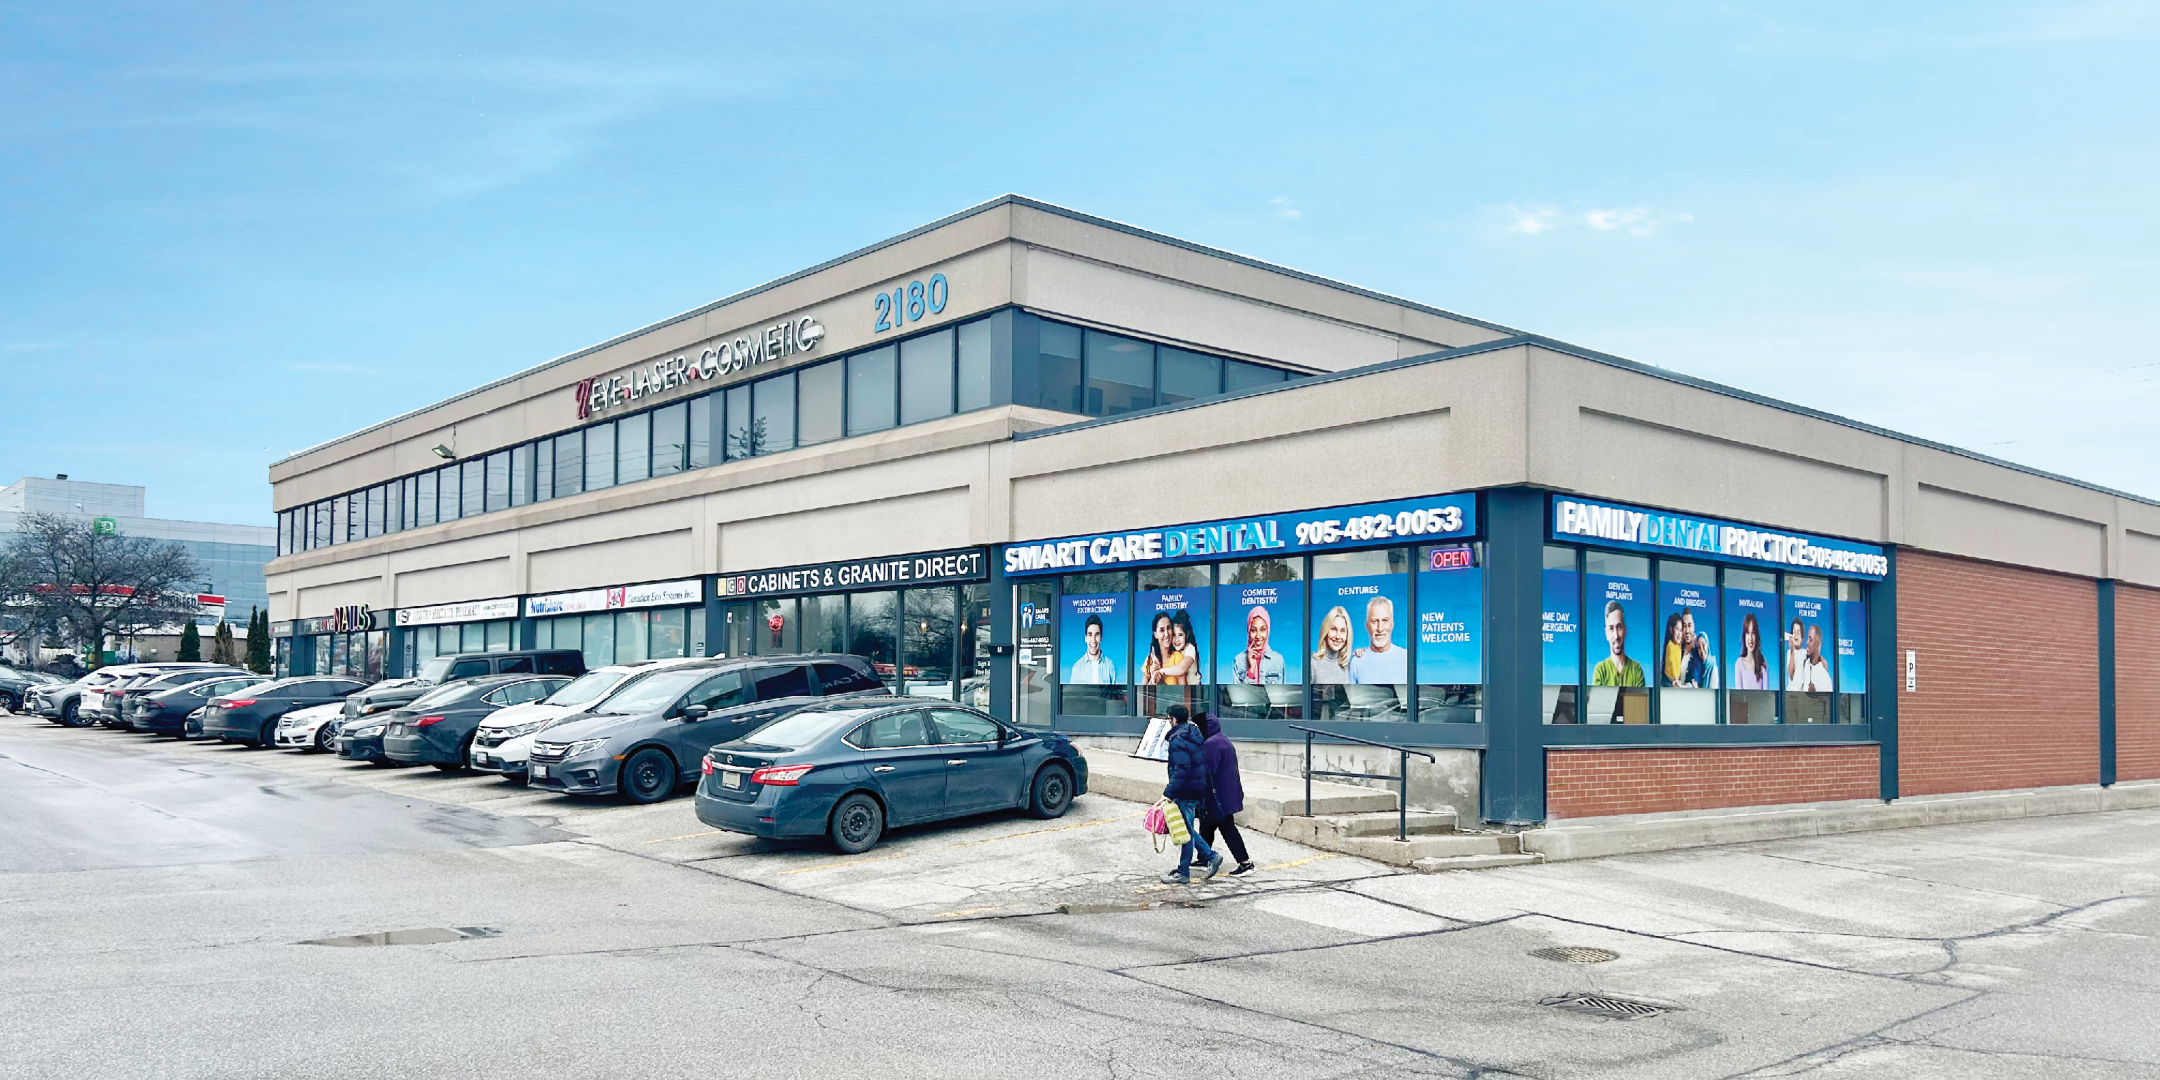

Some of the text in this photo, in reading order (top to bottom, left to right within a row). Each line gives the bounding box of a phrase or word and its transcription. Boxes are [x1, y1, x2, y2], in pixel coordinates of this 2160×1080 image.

[874, 273, 949, 333] 2180
[698, 314, 821, 381] COSMETIC
[1005, 506, 1462, 573] SMART CARE DENTAL 905-482-0053
[1557, 500, 1888, 576] FAMILY DENTAL PRACTICE 905-482-0053
[1433, 550, 1470, 568] OPEN
[749, 569, 820, 593] CABINETS
[823, 568, 834, 586] &
[838, 560, 910, 586] GRANITE
[914, 553, 981, 579] DIRECT
[1338, 586, 1379, 596] DENTURES
[1608, 582, 1630, 591] DENTAL
[1242, 588, 1277, 597] COSMETIC
[1605, 591, 1633, 600] IMPLANTS
[1680, 590, 1700, 598] CROWN
[1241, 596, 1278, 605] DENTISTRY
[1156, 602, 1188, 610] DENTISTRY
[1422, 612, 1444, 622] NEW
[1556, 612, 1571, 622] DAY
[1422, 622, 1464, 632] PATIENTS
[1422, 632, 1470, 642] WELCOME
